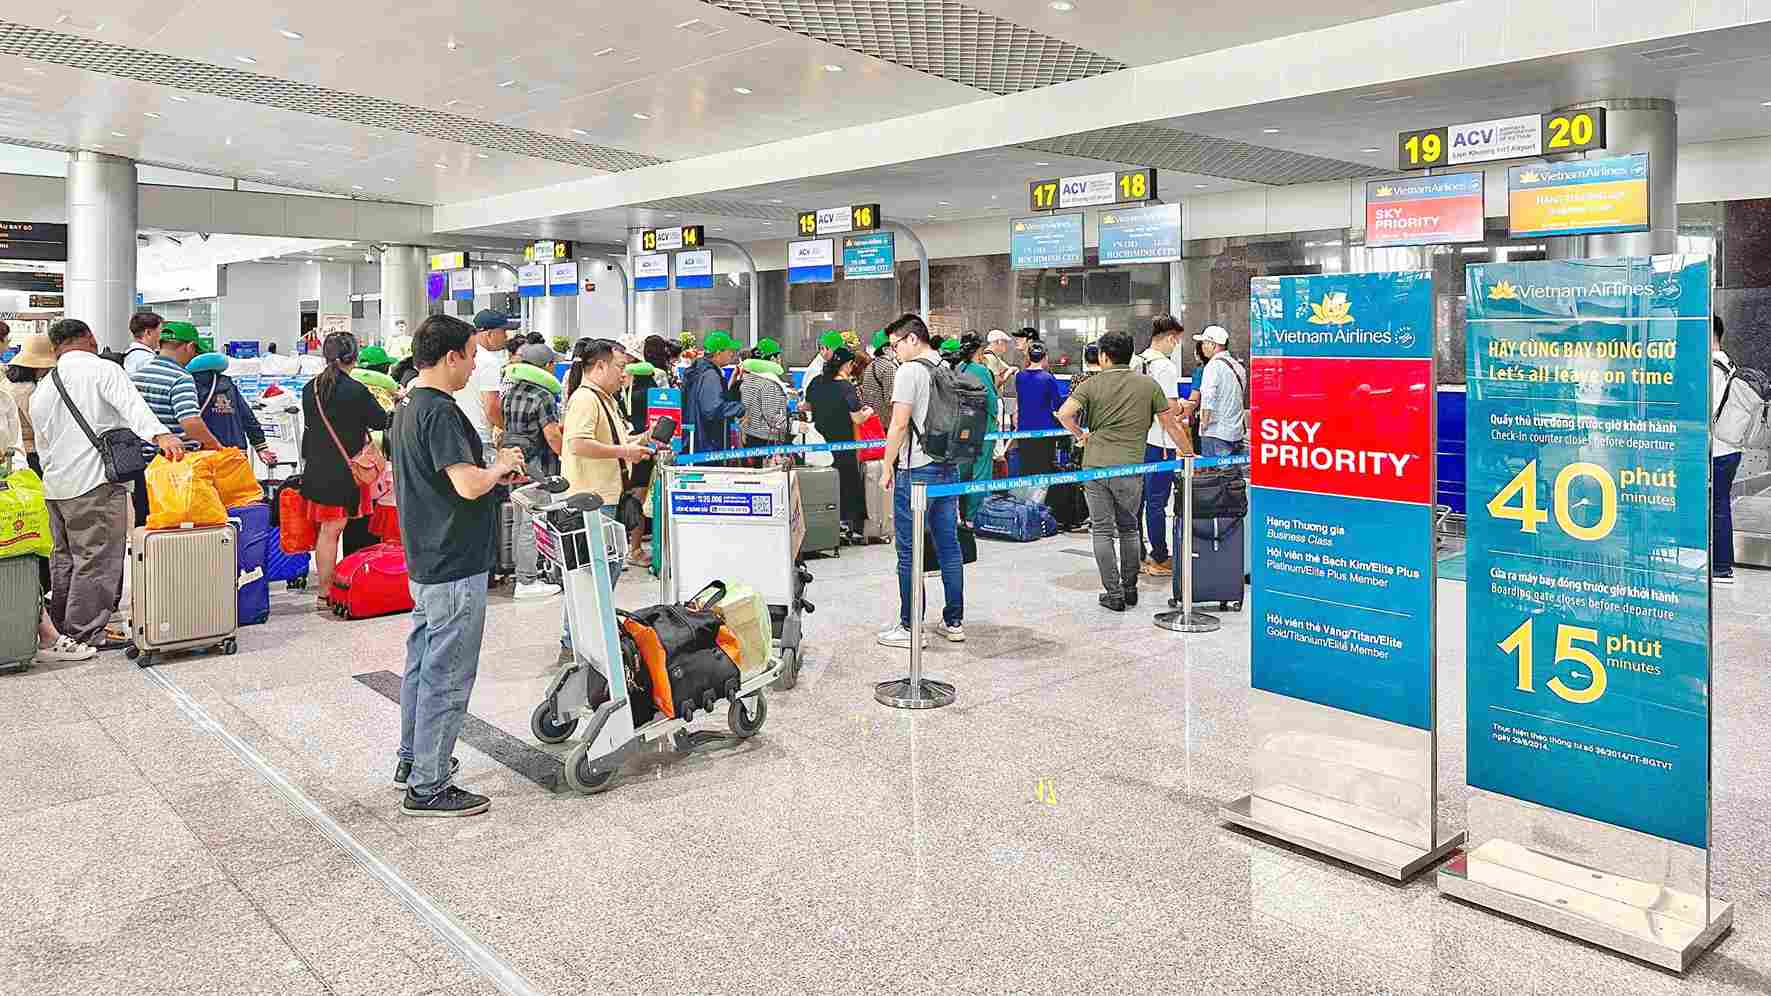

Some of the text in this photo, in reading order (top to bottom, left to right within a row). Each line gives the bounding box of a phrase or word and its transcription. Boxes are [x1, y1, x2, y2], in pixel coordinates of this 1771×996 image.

[1453, 128, 1493, 148] ACV
[1547, 113, 1594, 148] 20
[1404, 134, 1441, 164] 19
[1063, 181, 1088, 195] ACV
[1120, 173, 1146, 198] 18
[1033, 184, 1057, 208] 17
[799, 214, 816, 233] 15
[818, 213, 834, 224] ACV
[1375, 207, 1402, 220] SKY
[1375, 216, 1440, 231] PRIORITY
[643, 232, 656, 249] 13
[683, 227, 696, 245] 14
[1519, 282, 1655, 299] Vietnam Airlines
[1274, 328, 1392, 344] Vietnam Airlines
[1488, 337, 1516, 358] HÃY
[1519, 337, 1559, 358] CÙNG
[1563, 341, 1593, 359] BAY
[1596, 337, 1643, 359] ĐÚNG
[1489, 364, 1525, 382] Let's
[1528, 366, 1549, 383] all
[1604, 369, 1625, 384] on
[1631, 368, 1673, 385] time
[1260, 418, 1321, 443] SKY
[1529, 433, 1562, 444] counter
[1626, 437, 1675, 451] departure
[1260, 443, 1411, 477] PRIORITY
[1620, 466, 1676, 489] phút
[1487, 459, 1617, 541] 40
[1621, 492, 1676, 507] minutes
[1267, 529, 1332, 546] Business Class
[1266, 559, 1389, 588] Platinum/Elite Plus Member
[1396, 566, 1420, 578] Plus
[1491, 582, 1531, 600] Boarding
[1556, 593, 1586, 607] closes
[1588, 596, 1621, 610] before
[1623, 603, 1674, 620] departure
[1266, 626, 1389, 659] Gold/Titanium/Elite Member
[1606, 633, 1662, 659] phút
[1497, 618, 1607, 703] 15
[1606, 656, 1661, 675] minutes
